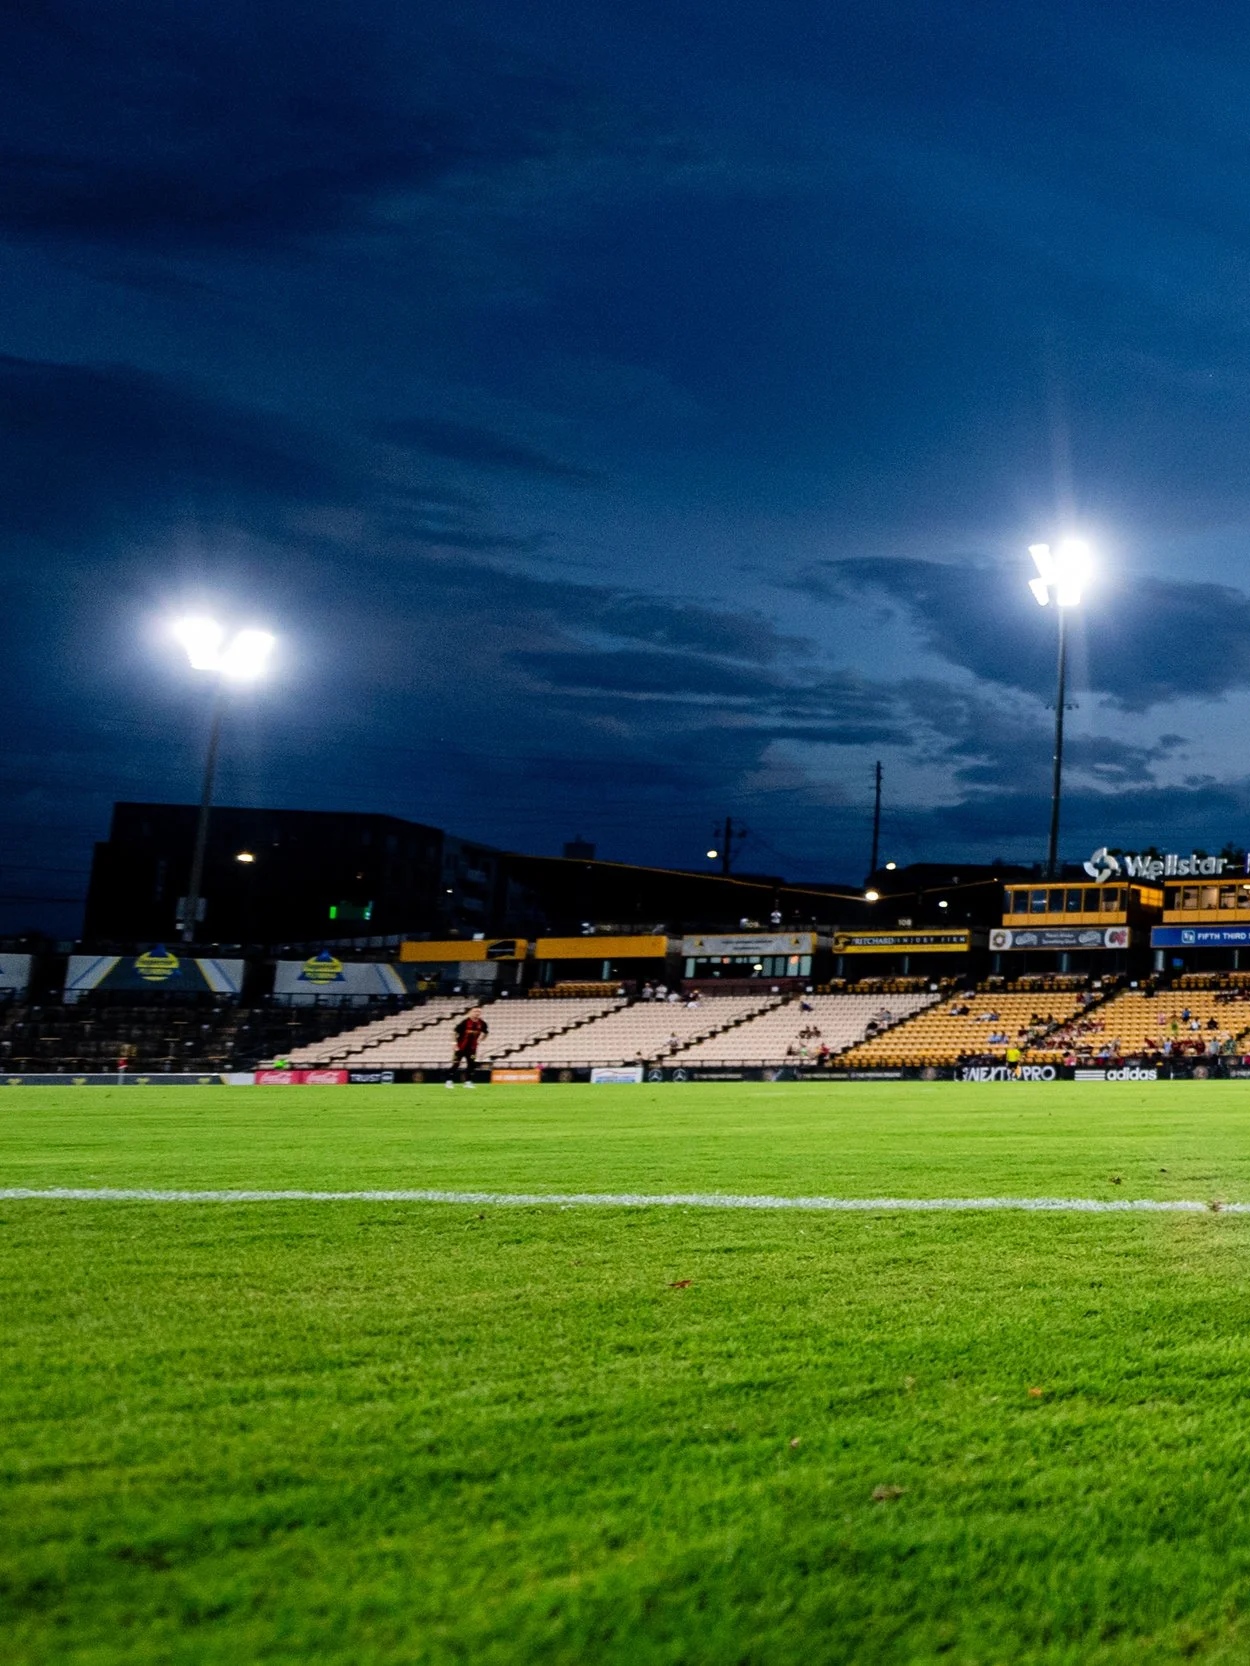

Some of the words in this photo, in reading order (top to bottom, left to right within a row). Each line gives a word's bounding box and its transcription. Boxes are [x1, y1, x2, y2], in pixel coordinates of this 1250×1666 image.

[1124, 854, 1228, 876] Wellstar
[1198, 932, 1220, 941] FIFTH
[1223, 932, 1247, 940] THIRD
[1022, 1065, 1056, 1081] PRO
[1107, 1067, 1158, 1081] adidas
